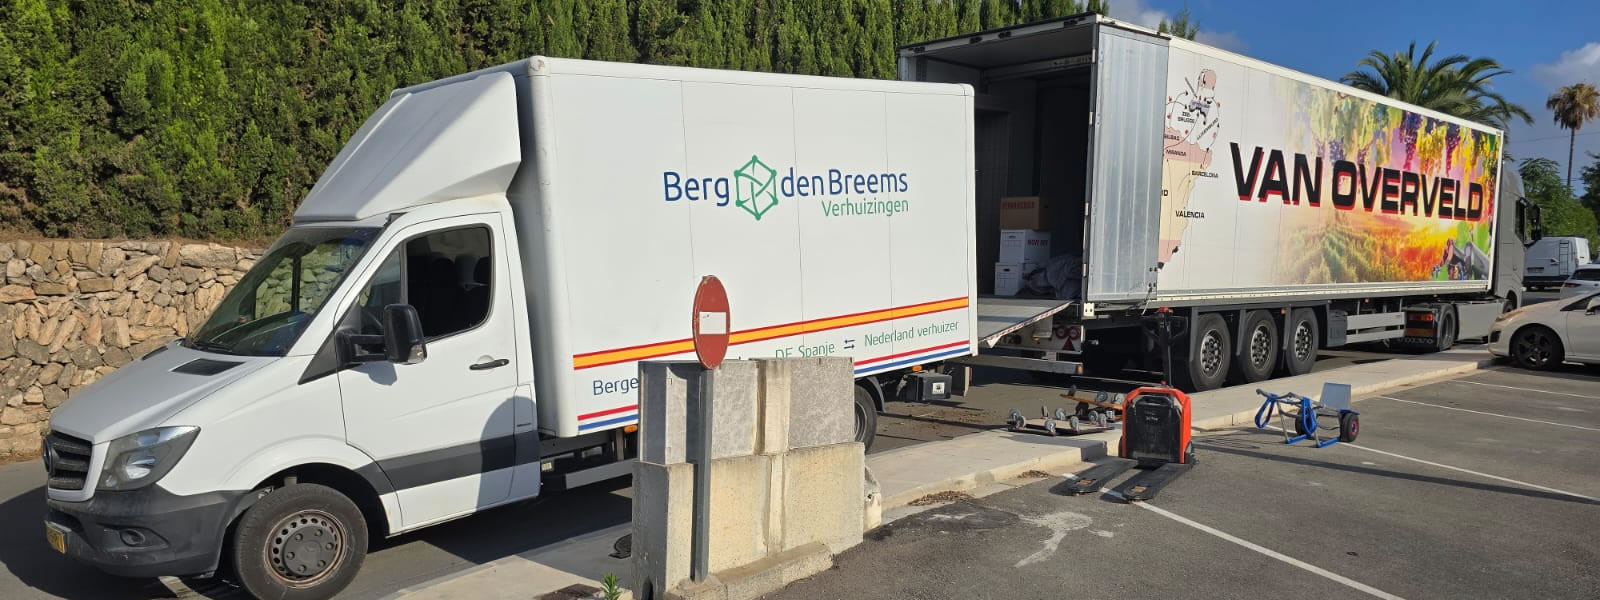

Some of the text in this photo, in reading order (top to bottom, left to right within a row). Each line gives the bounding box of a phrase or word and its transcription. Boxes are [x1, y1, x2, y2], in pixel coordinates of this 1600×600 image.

[663, 167, 908, 207] Berg den Breems
[1191, 170, 1219, 178] BARCELONA
[1230, 142, 1483, 222] VAN OVERVELD
[821, 198, 909, 217] Verhuizingen
[1175, 210, 1205, 219] VALENCIA
[798, 342, 835, 358] Spanje
[864, 326, 914, 347] Nederland
[917, 321, 959, 337] verhuizer
